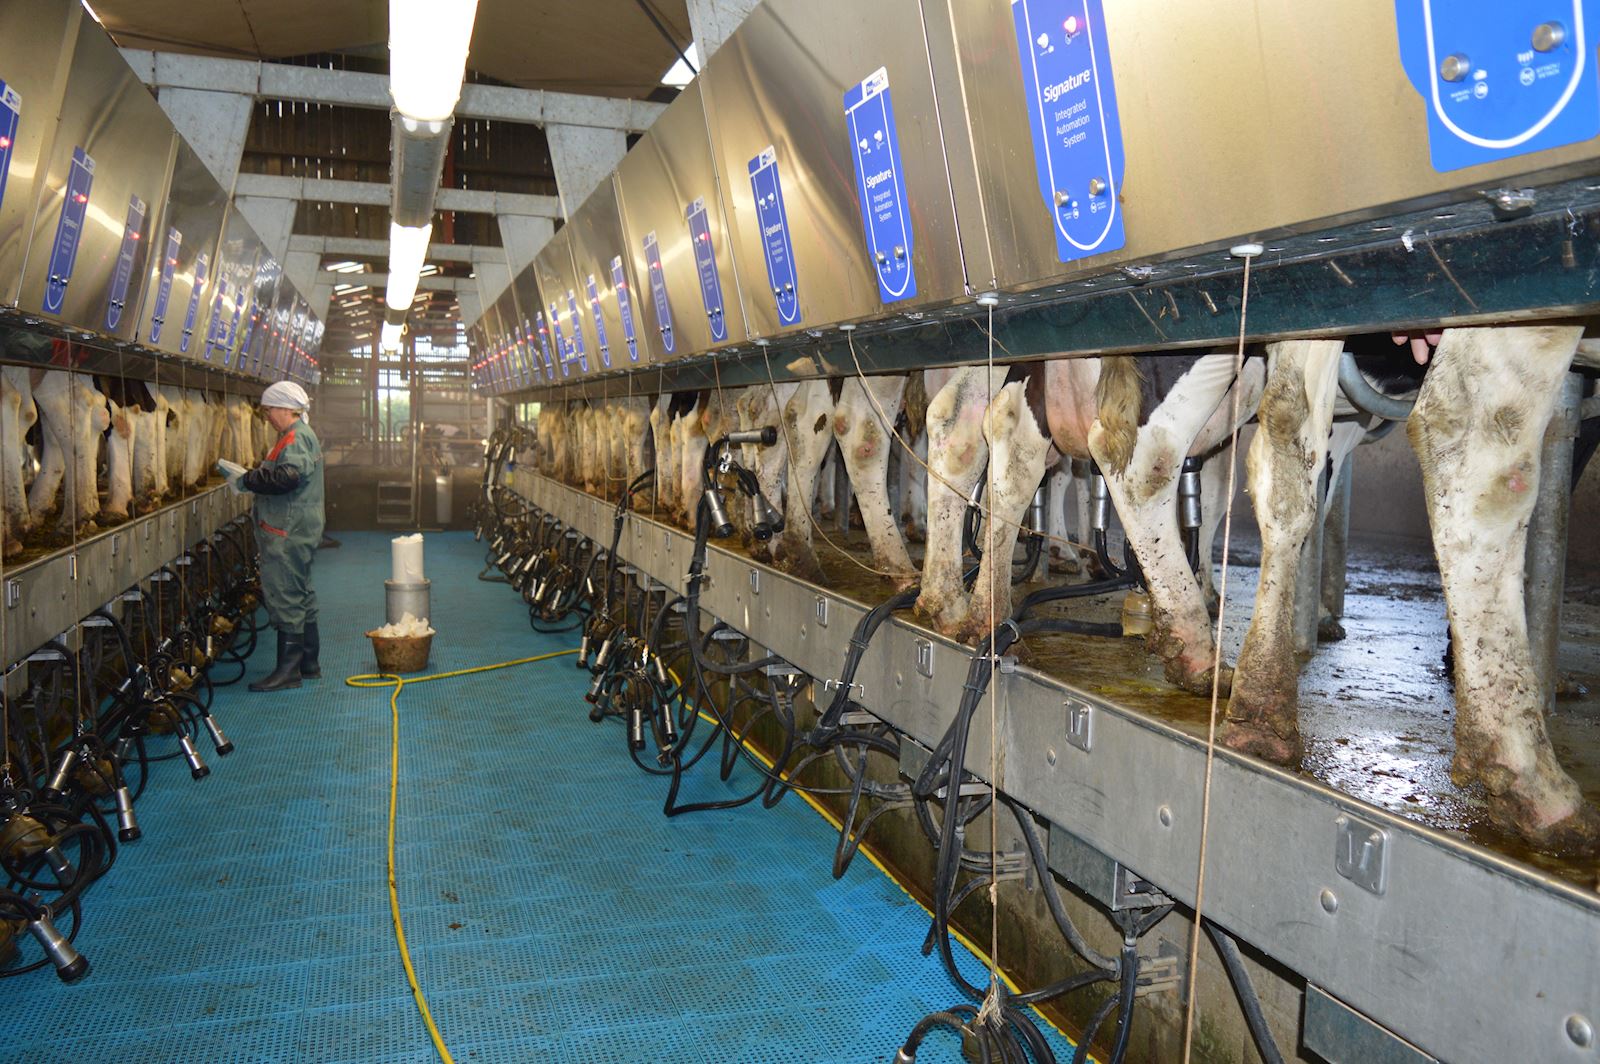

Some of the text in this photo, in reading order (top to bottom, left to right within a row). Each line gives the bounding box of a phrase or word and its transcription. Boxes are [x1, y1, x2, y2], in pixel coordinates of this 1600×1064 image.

[1043, 69, 1090, 103] Signature
[1054, 98, 1086, 122] Integrated
[1056, 114, 1090, 136] Automation
[1063, 131, 1086, 149] System
[866, 169, 892, 189] Signature
